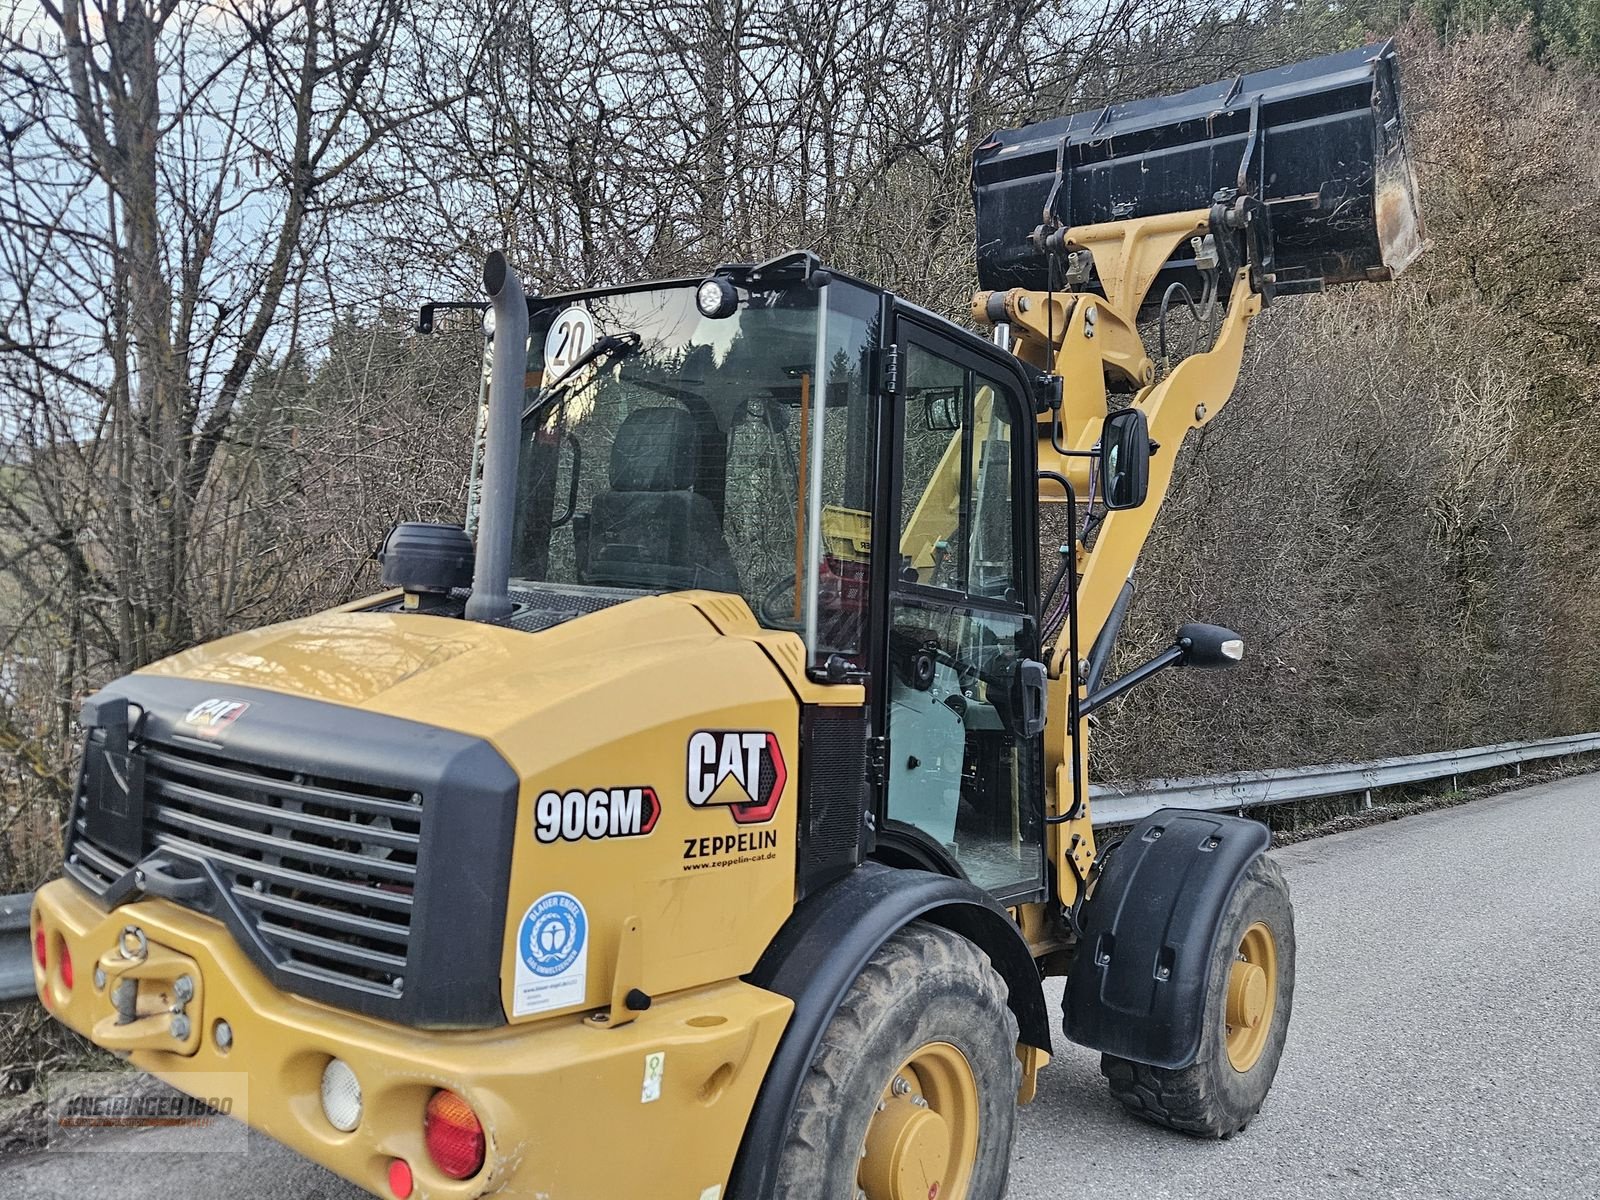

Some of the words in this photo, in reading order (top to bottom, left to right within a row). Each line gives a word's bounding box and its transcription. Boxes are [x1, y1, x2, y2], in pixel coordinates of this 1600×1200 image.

[553, 321, 585, 367] 20
[186, 699, 244, 726] CAT
[688, 732, 766, 805] CAT
[537, 789, 642, 841] 906M
[683, 829, 777, 859] ZEPPELIN
[683, 852, 776, 871] www.zeppelin-cat.de
[529, 897, 559, 921] BLAUER
[560, 897, 580, 918] ENGEL
